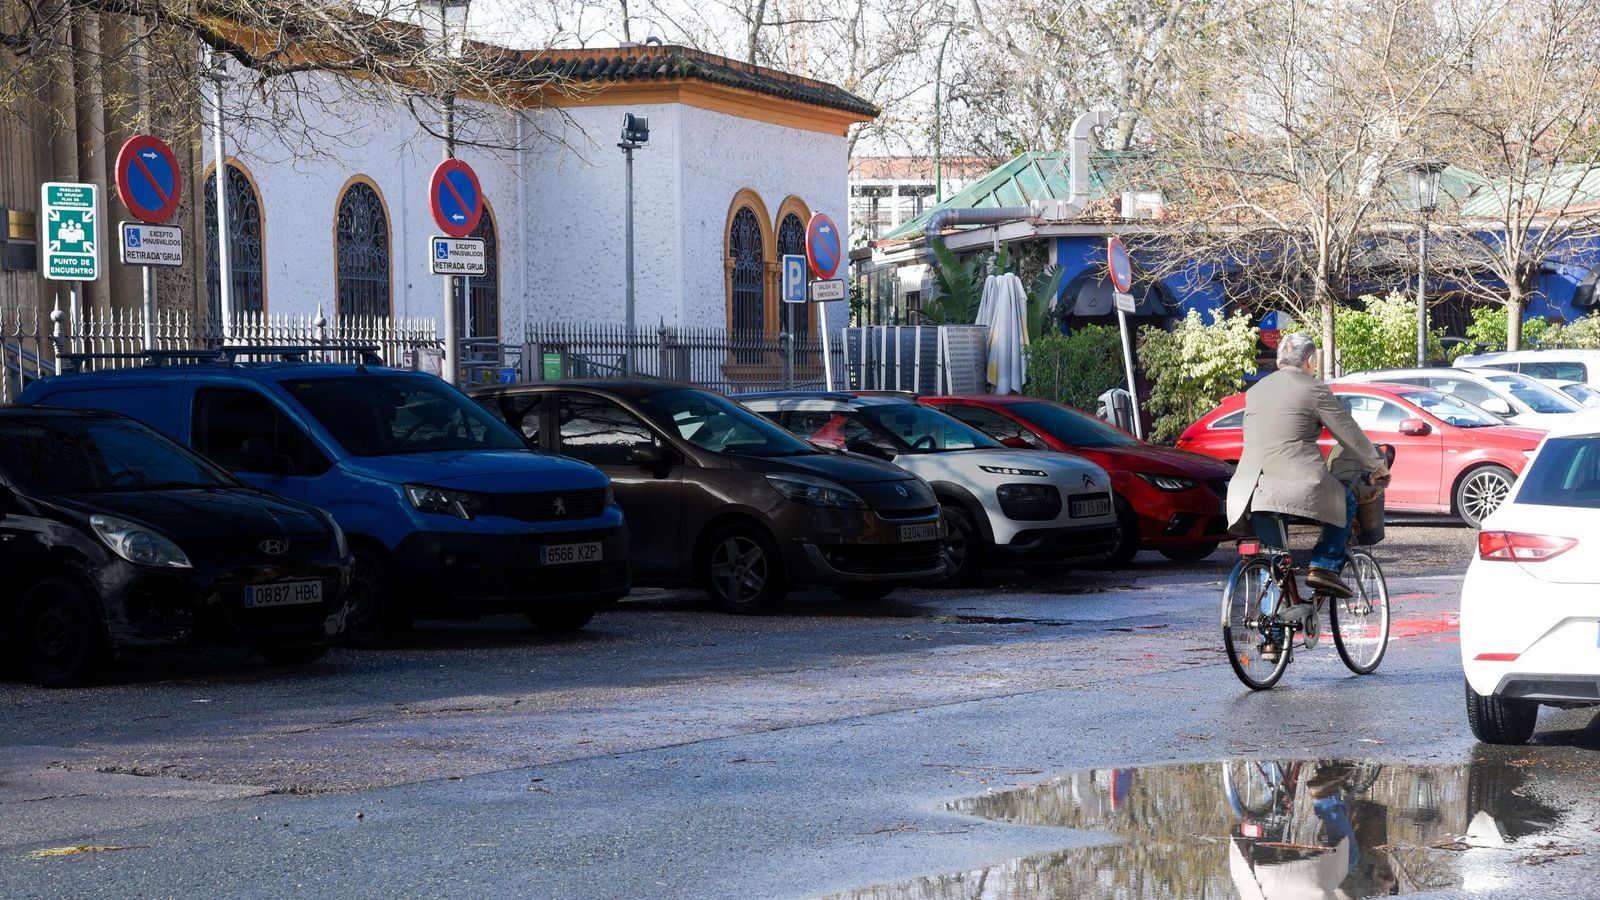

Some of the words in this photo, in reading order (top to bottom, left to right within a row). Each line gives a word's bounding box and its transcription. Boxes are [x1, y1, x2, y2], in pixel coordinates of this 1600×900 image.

[149, 230, 174, 239] EXCEPTO
[142, 238, 181, 247] MINUSVALIDOS
[53, 257, 78, 266] PUNTO
[80, 258, 90, 266] DE
[127, 250, 161, 261] RETIRADA
[162, 252, 182, 262] GRUA
[50, 266, 94, 275] ENCUENTRO
[434, 261, 465, 271] RETIRADA
[466, 262, 484, 271] GRUA
[788, 260, 802, 297] P
[1077, 501, 1094, 514] 8115
[902, 526, 920, 540] 3204
[548, 546, 574, 562] 6566
[578, 544, 597, 560] KZP
[255, 585, 290, 604] 0887
[295, 583, 320, 601] HBC
